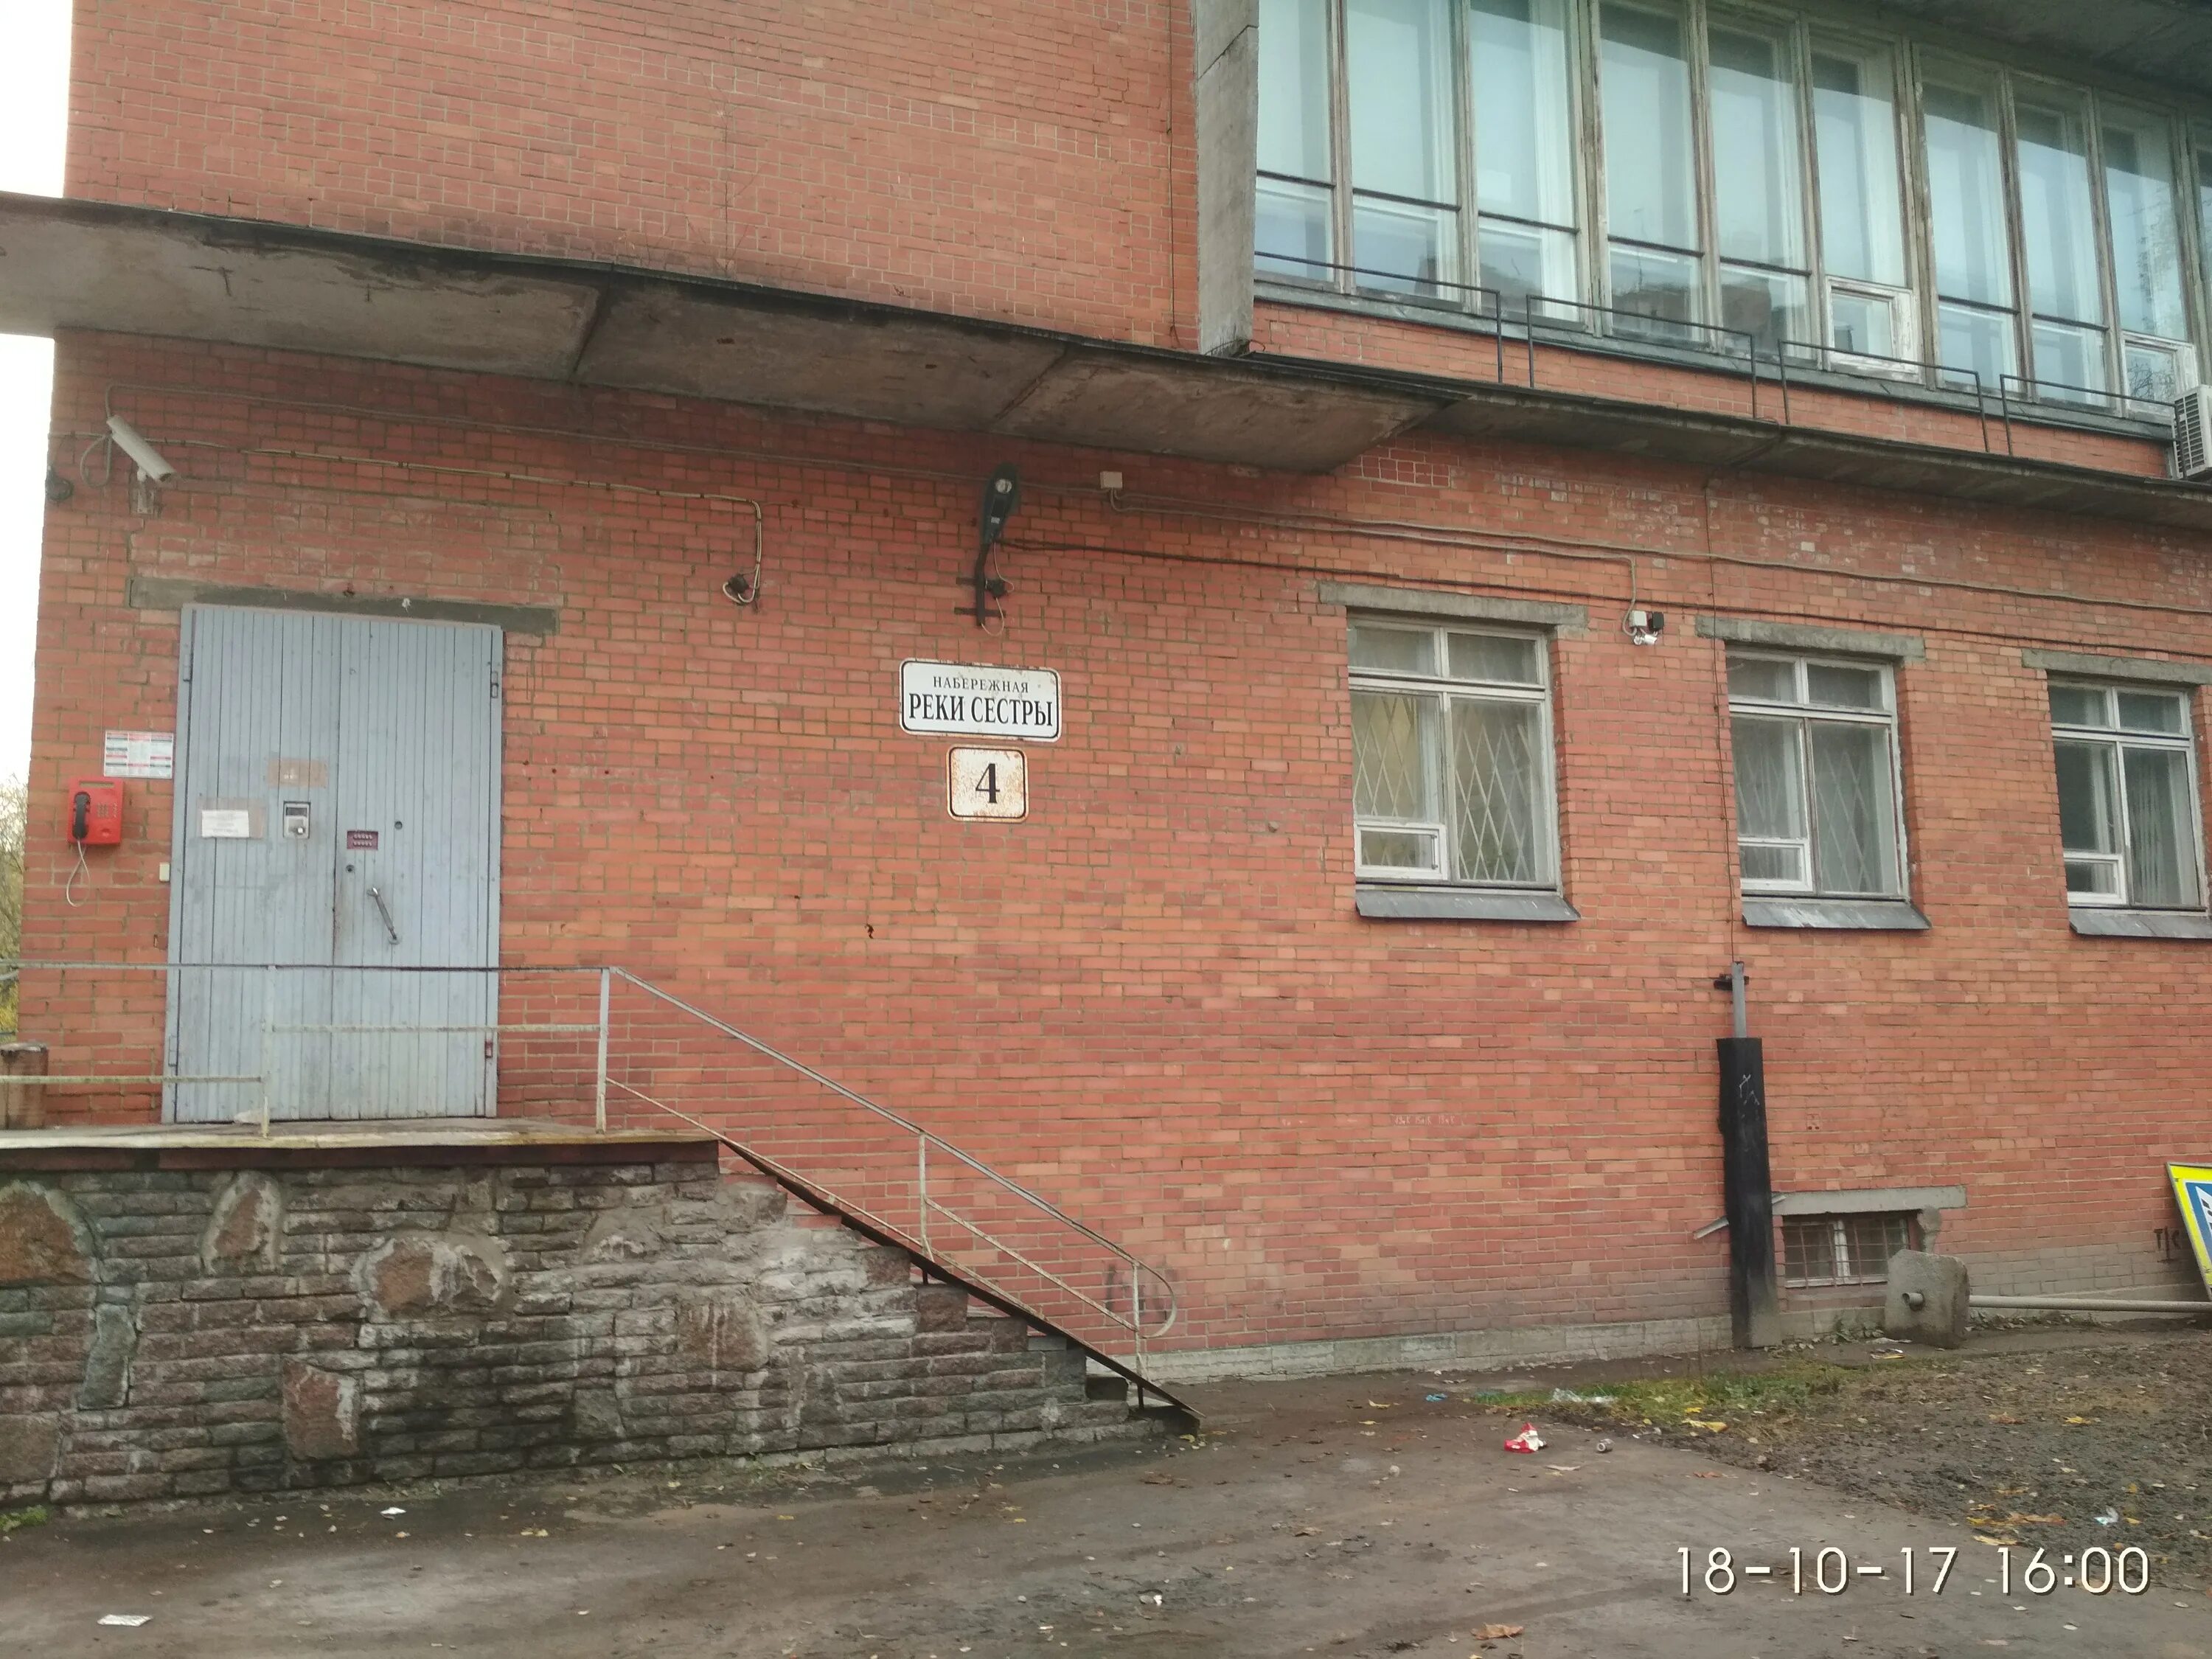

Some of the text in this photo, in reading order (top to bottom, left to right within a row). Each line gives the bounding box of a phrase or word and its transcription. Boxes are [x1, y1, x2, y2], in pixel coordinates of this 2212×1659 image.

[933, 675, 1029, 693] НАБЕРЕЖНАЯ
[908, 692, 1053, 726] РЕКИ СЕСТРЫ
[975, 762, 1001, 804] 4
